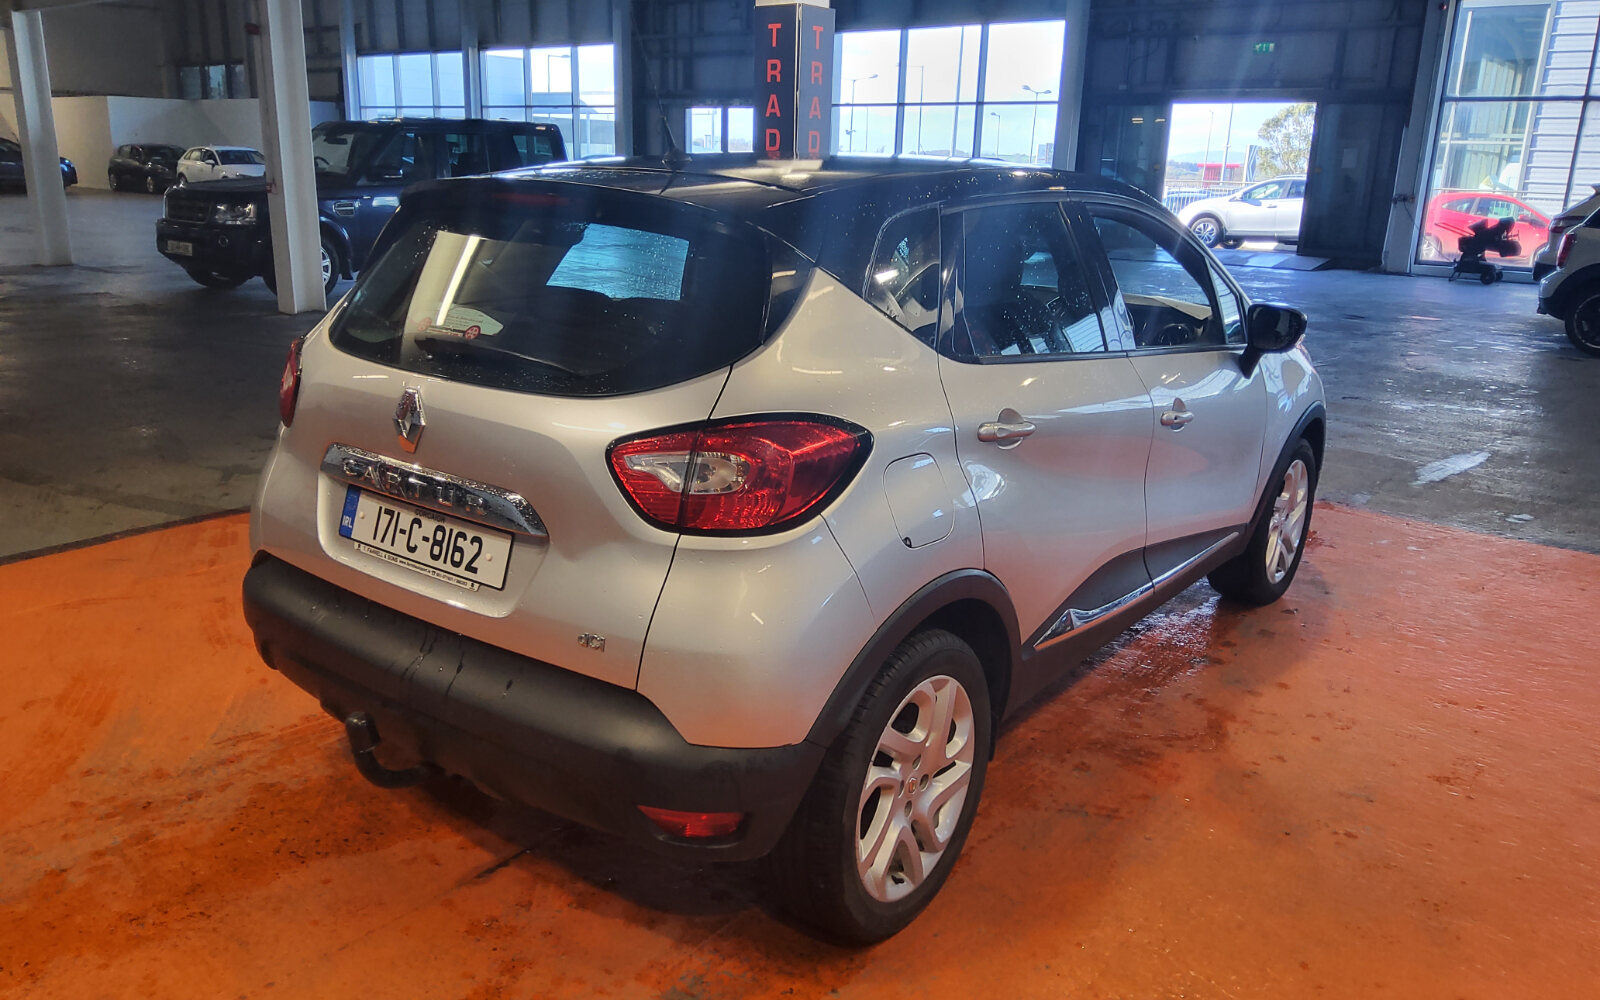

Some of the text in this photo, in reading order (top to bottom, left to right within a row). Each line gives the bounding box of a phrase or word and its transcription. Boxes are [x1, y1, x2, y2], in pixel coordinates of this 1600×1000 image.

[342, 458, 487, 516] CAPTUR
[341, 514, 353, 529] IRL
[373, 506, 483, 574] 171-C-8162
